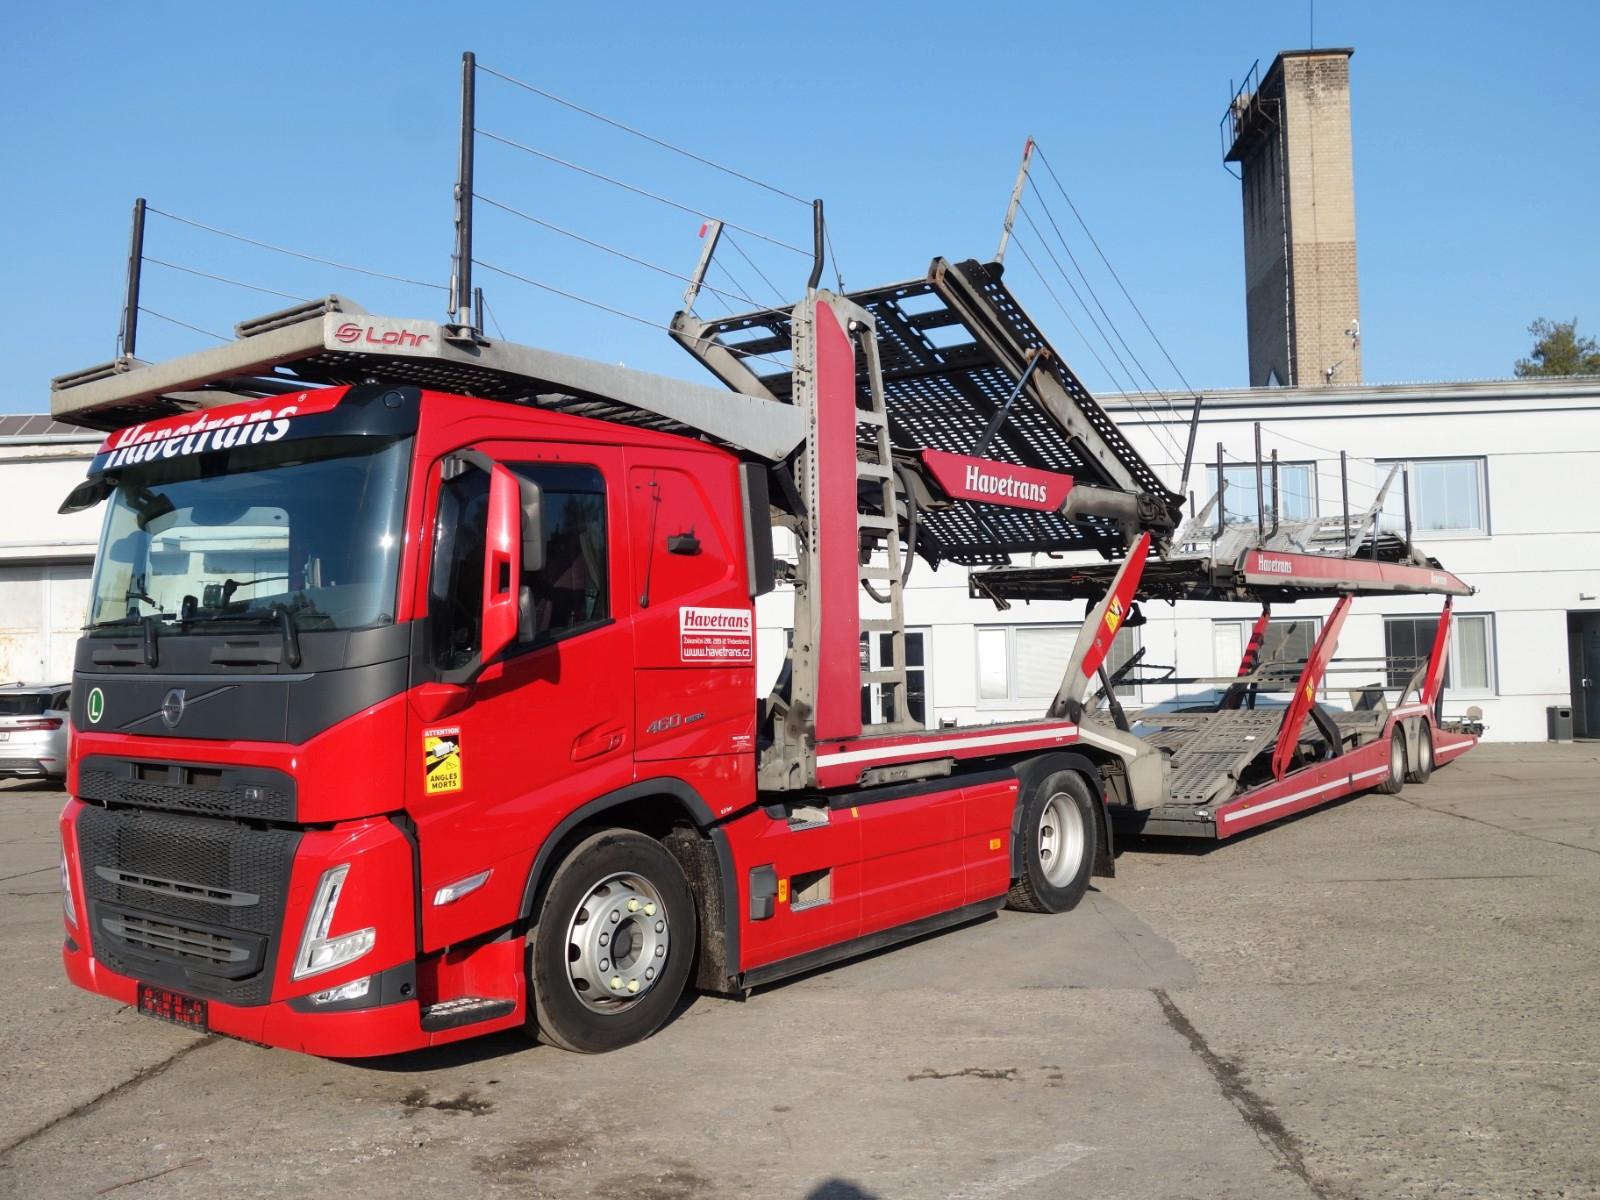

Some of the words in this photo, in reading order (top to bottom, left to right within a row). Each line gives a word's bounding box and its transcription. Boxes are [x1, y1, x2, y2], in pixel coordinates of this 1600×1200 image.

[366, 327, 429, 346] Lohr
[102, 406, 298, 469] Havetrans
[965, 464, 1047, 502] Havetrans
[1258, 554, 1292, 573] Havetrans
[684, 610, 749, 628] Havetrans
[683, 646, 750, 657] www.havetrans.cz
[91, 695, 99, 716] L
[424, 728, 460, 737] ATTENTION
[646, 713, 682, 734] 460
[430, 773, 458, 782] ANGLES
[432, 781, 457, 789] MORTS
